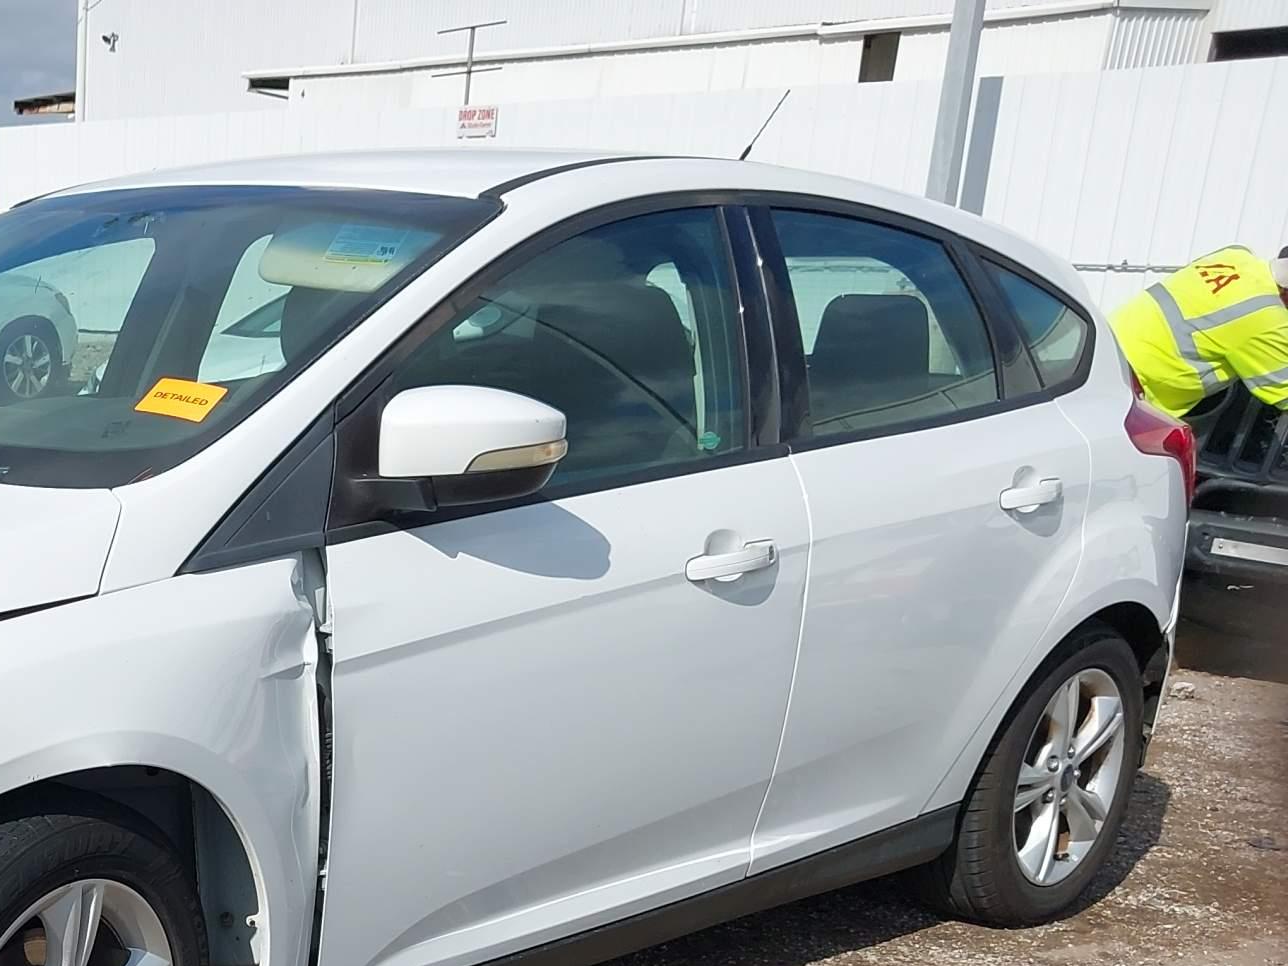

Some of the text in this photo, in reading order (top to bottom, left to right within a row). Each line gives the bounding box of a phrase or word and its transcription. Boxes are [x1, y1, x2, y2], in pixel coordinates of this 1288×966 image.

[458, 108, 495, 121] DROP ZONE
[153, 391, 209, 406] DETAILED
